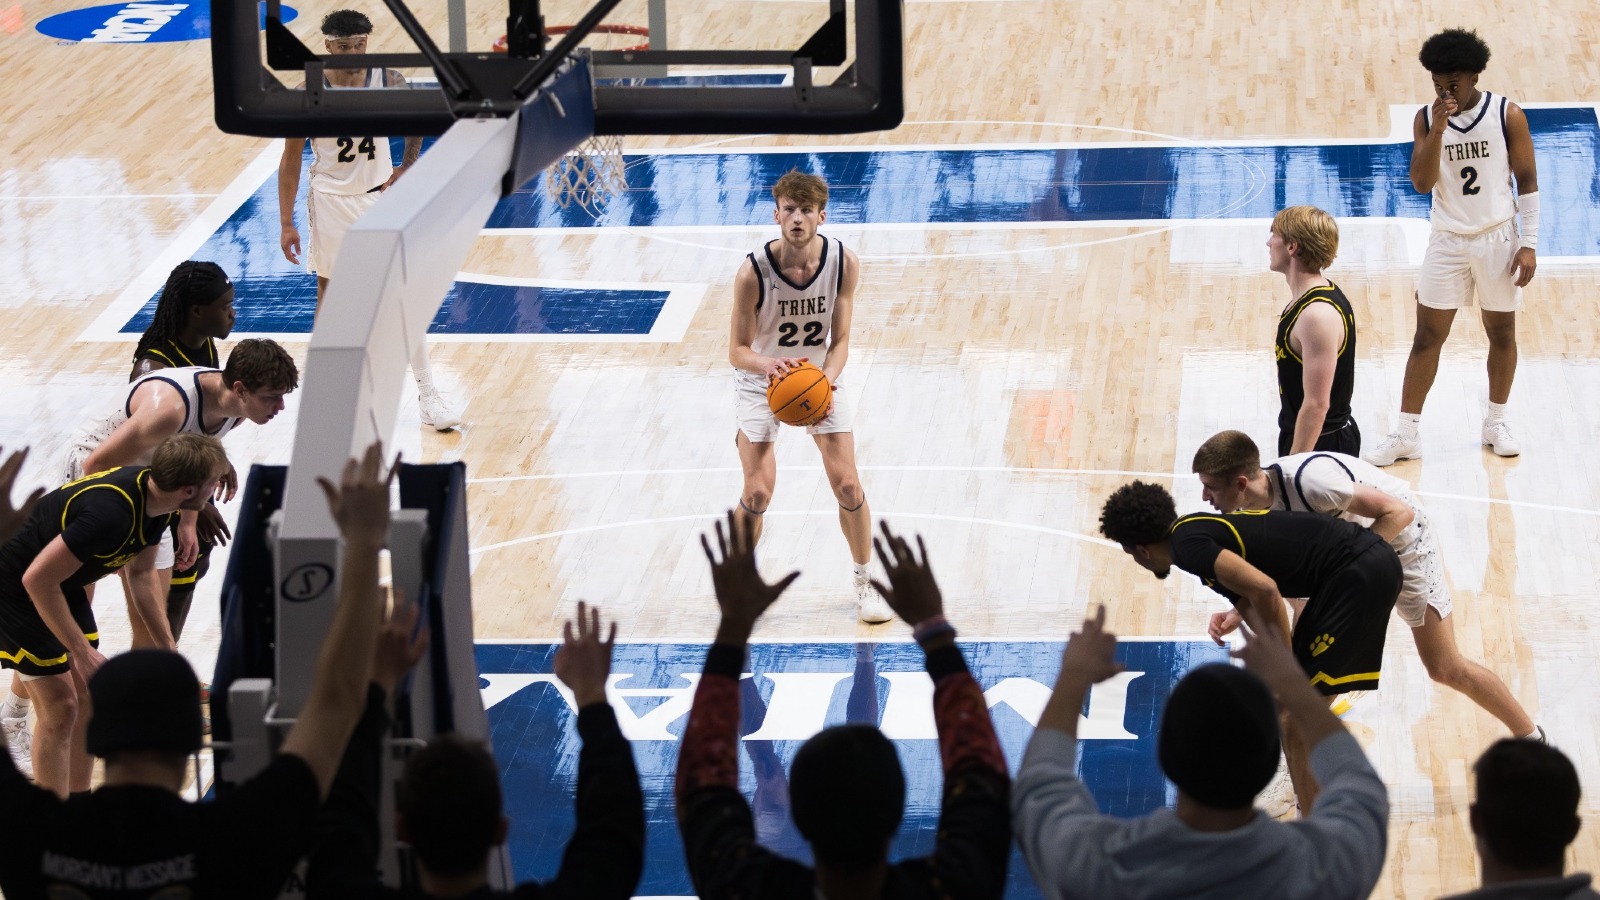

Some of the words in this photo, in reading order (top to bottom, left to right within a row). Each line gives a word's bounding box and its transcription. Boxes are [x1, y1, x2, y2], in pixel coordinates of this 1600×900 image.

[80, 3, 190, 43] NCAA
[336, 137, 376, 163] 24
[1444, 140, 1490, 161] TRINE
[1460, 166, 1481, 196] 2
[778, 296, 827, 317] TRINE
[778, 321, 825, 347] 22
[125, 852, 197, 890] MESSAGE
